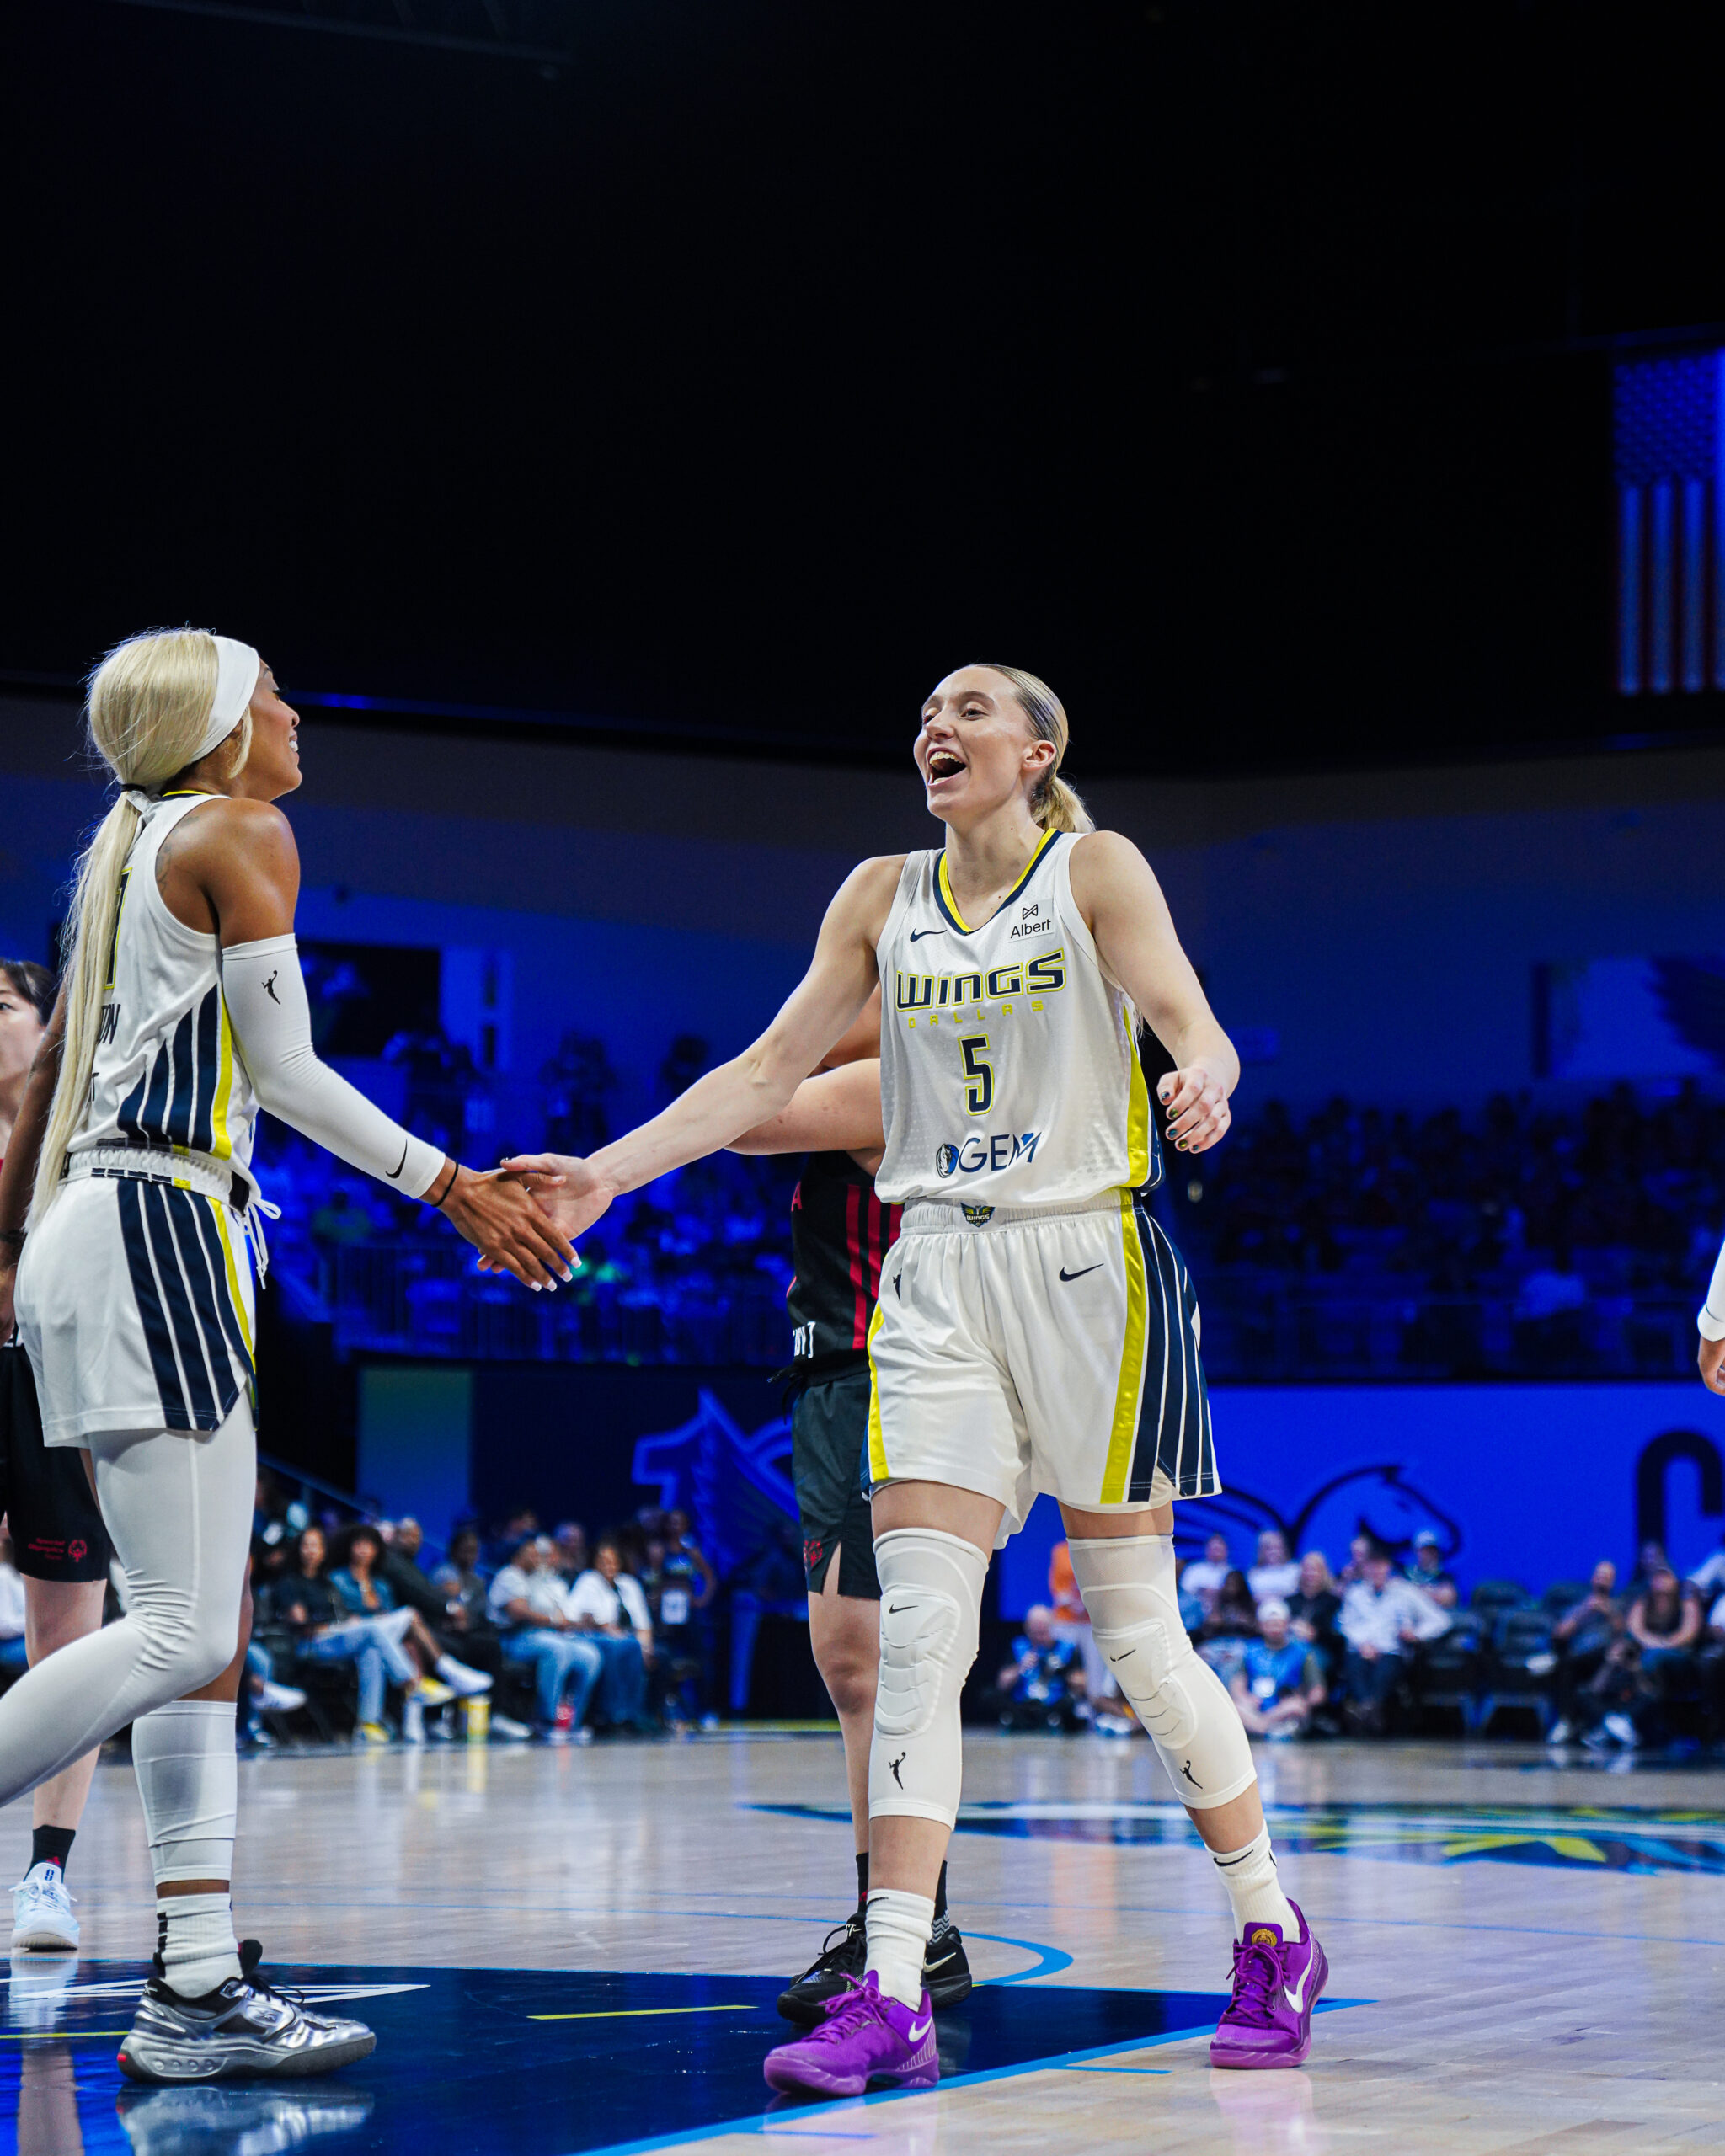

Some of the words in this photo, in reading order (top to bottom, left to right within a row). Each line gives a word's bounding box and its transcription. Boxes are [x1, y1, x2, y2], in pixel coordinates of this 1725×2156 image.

[1010, 918, 1052, 939] Albert
[895, 947, 1067, 1013] WINGS
[907, 999, 1044, 1029] DALLAS
[957, 1033, 996, 1117] 5
[958, 1131, 1043, 1173] GEM
